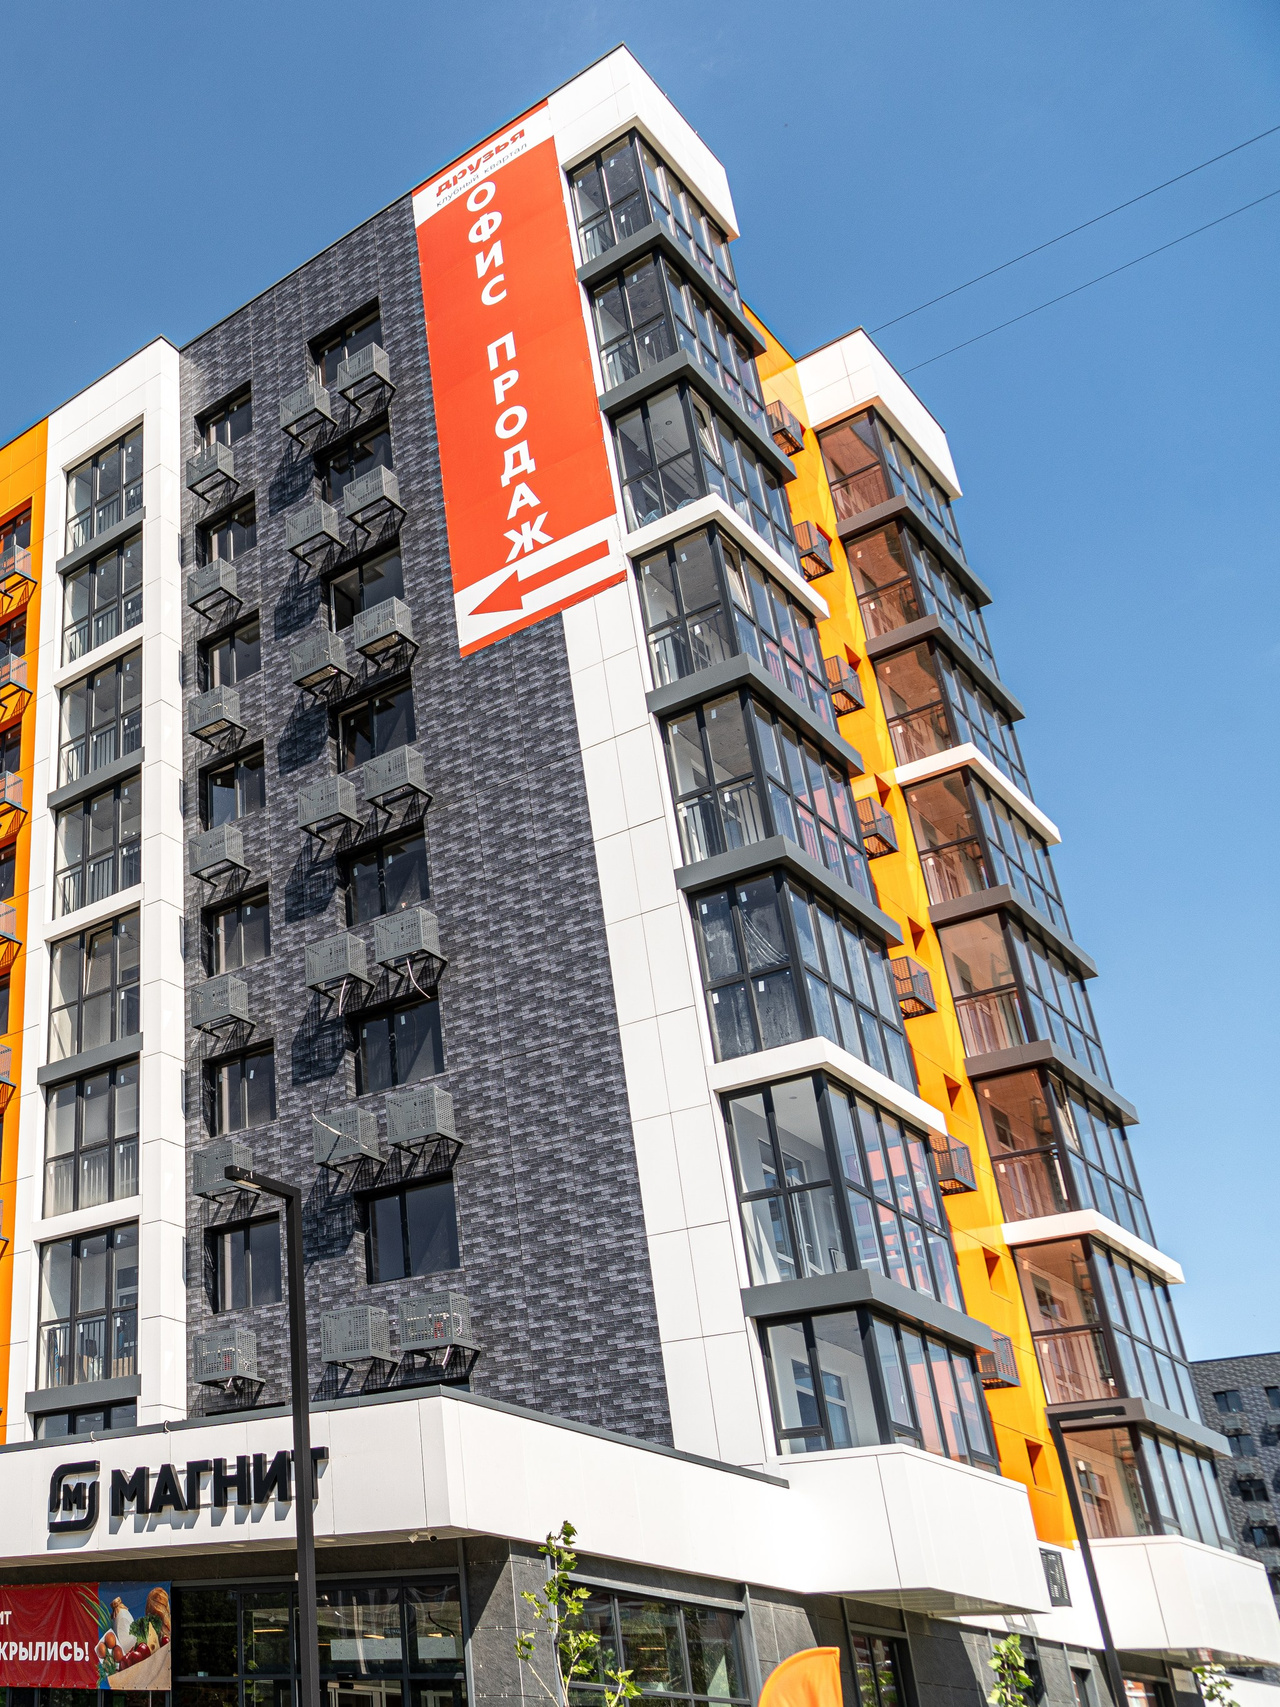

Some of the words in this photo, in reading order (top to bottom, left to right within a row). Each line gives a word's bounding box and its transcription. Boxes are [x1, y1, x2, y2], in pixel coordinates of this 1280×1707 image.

[436, 174, 480, 208] клубный
[484, 143, 527, 174] квартал
[466, 181, 507, 306] ОФИС
[487, 331, 554, 563] ПРОДАЖ
